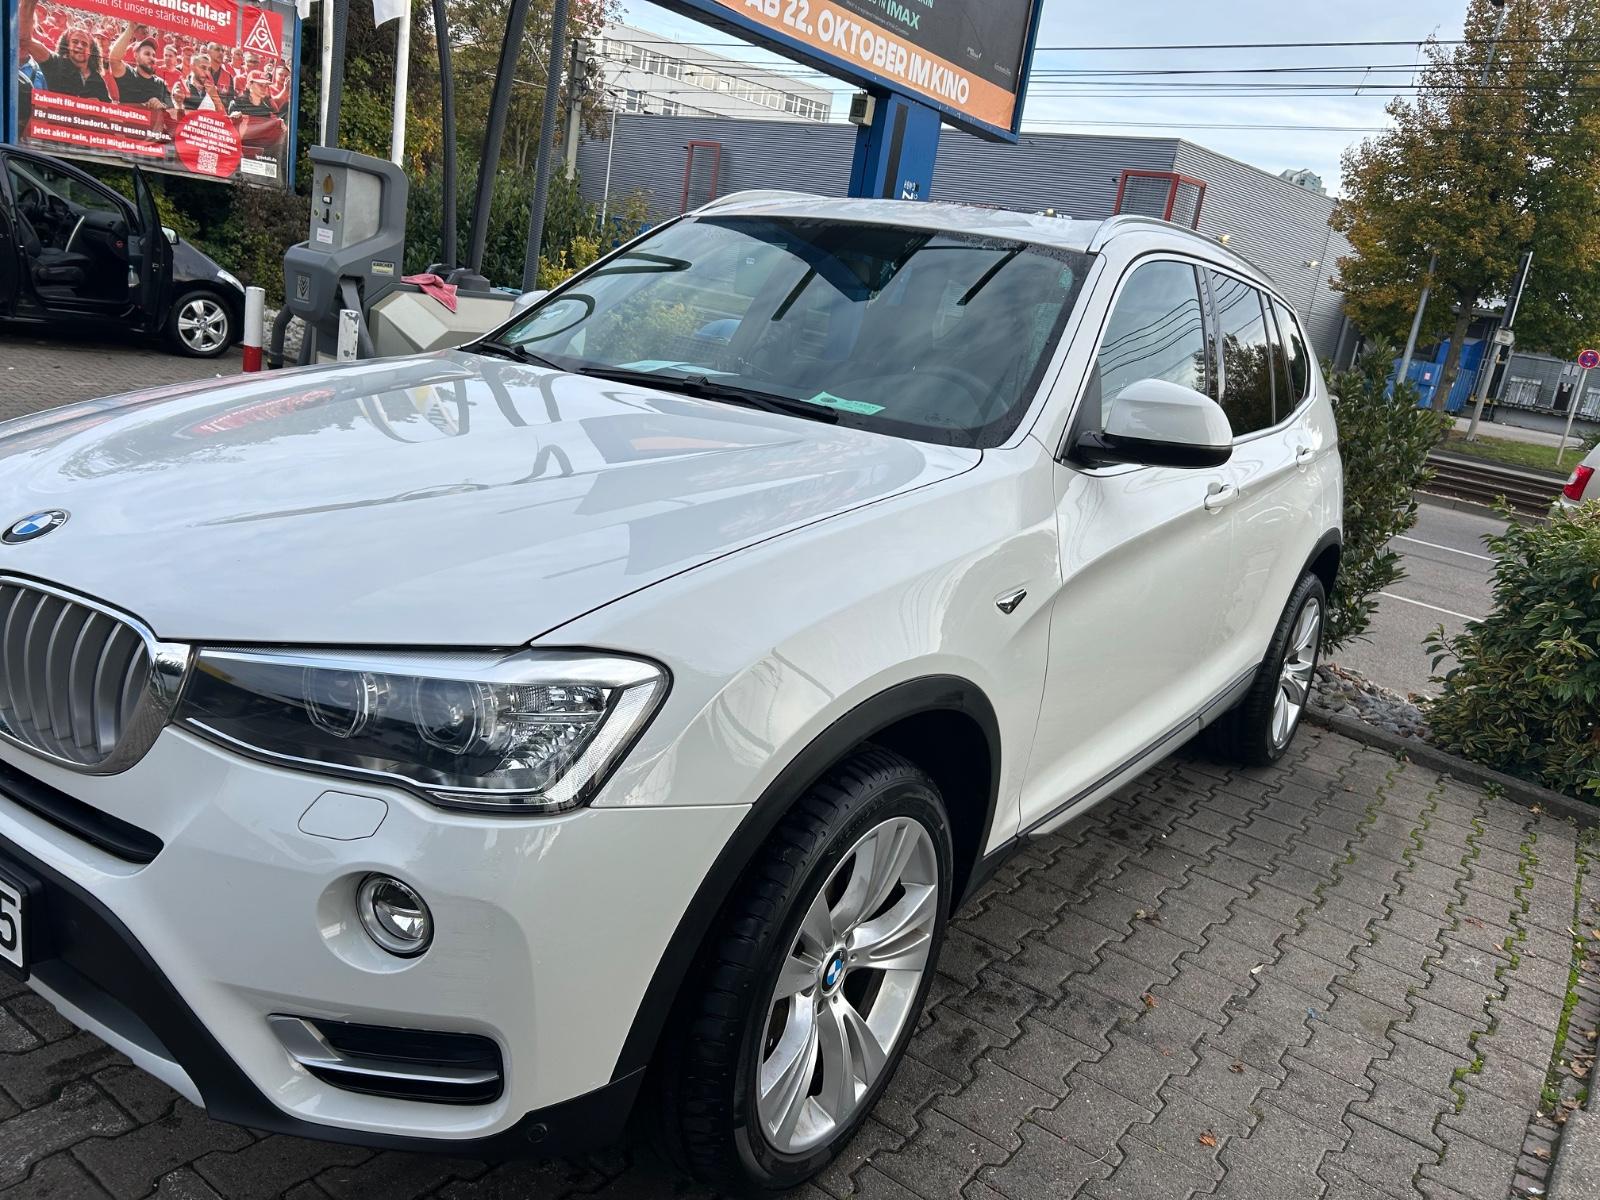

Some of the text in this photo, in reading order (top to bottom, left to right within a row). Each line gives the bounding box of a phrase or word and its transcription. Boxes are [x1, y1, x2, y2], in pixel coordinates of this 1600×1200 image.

[124, 2, 154, 17] unsere
[156, 8, 190, 26] stärkste
[191, 17, 218, 34] Marke.
[147, 0, 232, 27] ahlschlag!
[887, 0, 920, 30] IMAX
[783, 0, 813, 35] 22.
[817, 9, 908, 78] OKTOBER
[908, 52, 932, 88] IM
[930, 63, 970, 104] KINO
[34, 93, 63, 106] Zukunft
[63, 98, 76, 108] für
[76, 101, 101, 112] unsere
[34, 109, 172, 141] Für unsere Standorte. Für unsere Region.
[51, 130, 71, 139] aktiv
[71, 133, 88, 143] sein,
[89, 134, 106, 145] jetzt
[106, 137, 135, 150] Mitglied
[135, 143, 163, 153] werden!
[0, 889, 17, 951] 5
